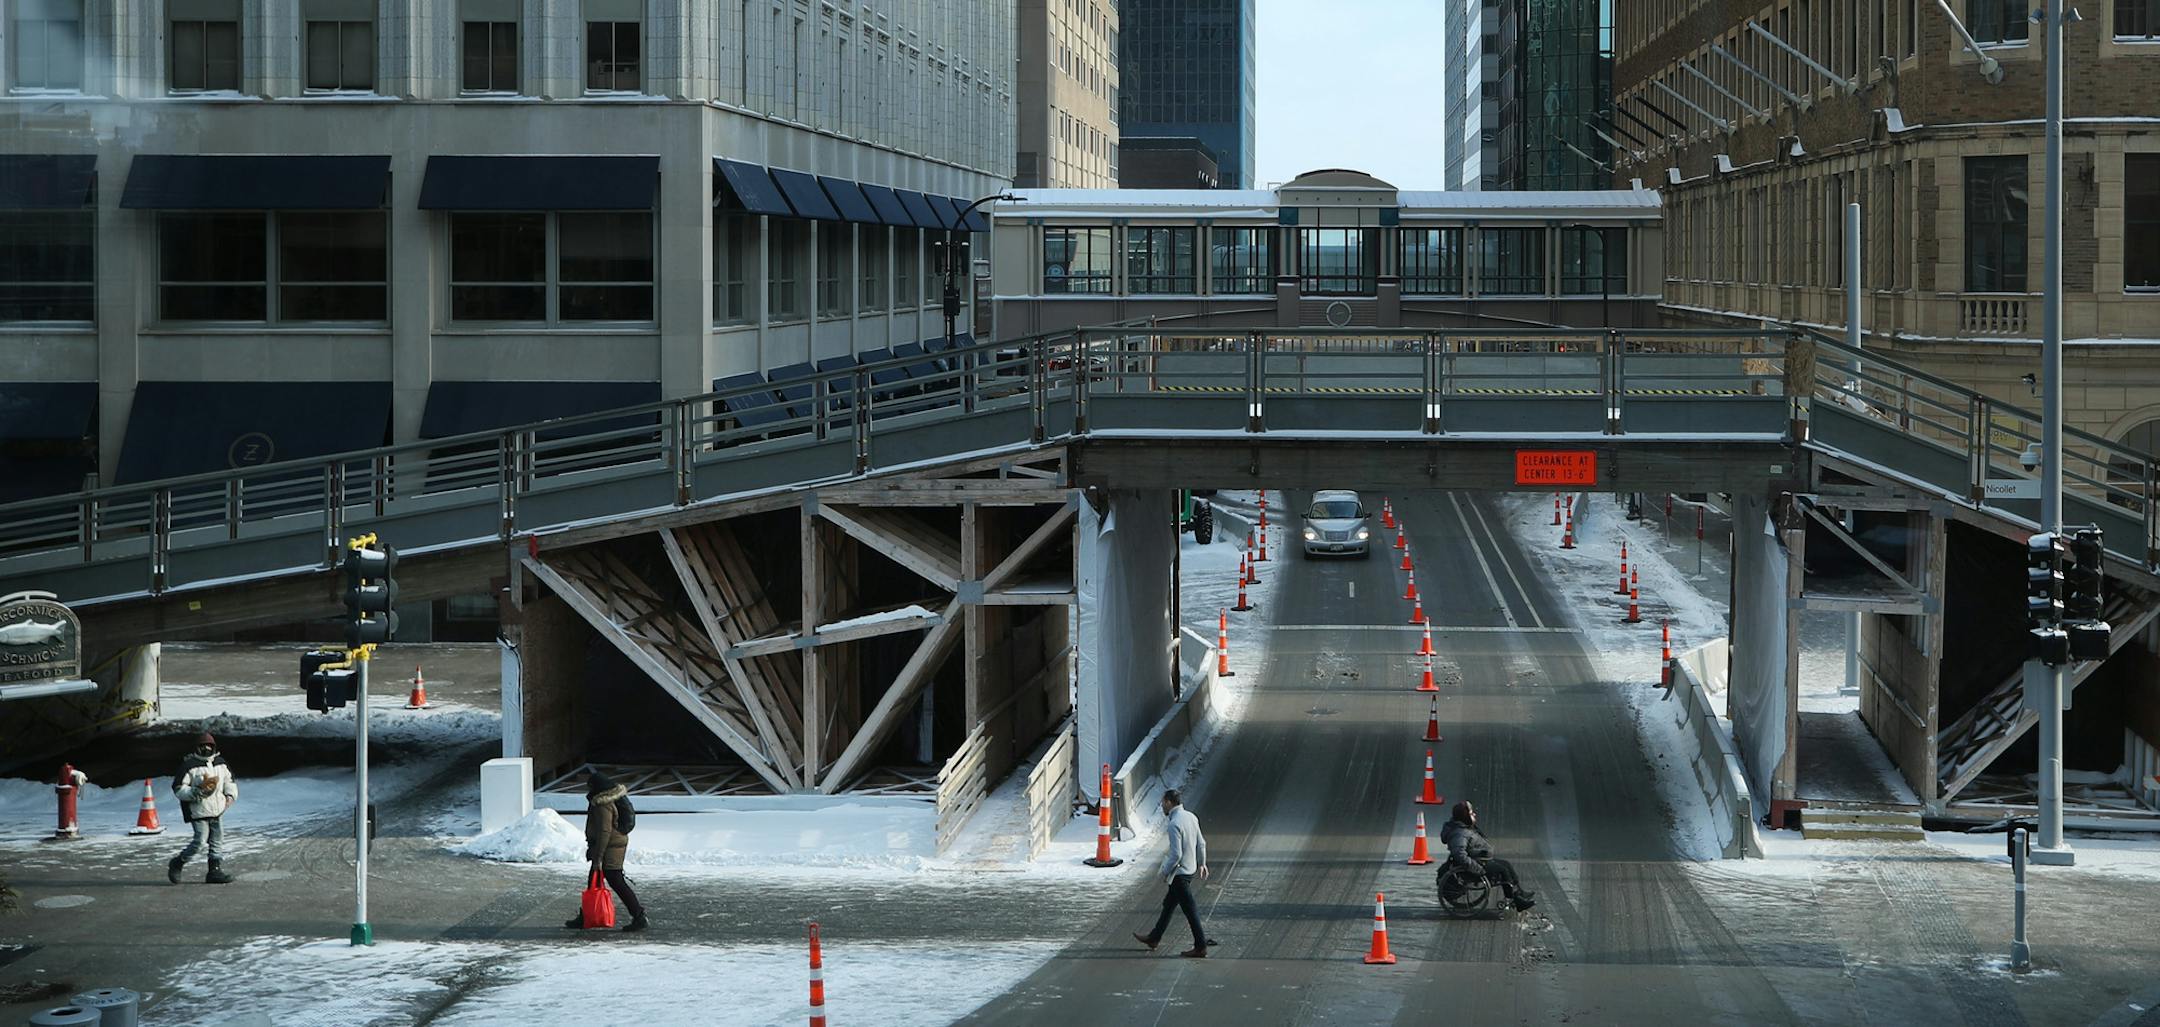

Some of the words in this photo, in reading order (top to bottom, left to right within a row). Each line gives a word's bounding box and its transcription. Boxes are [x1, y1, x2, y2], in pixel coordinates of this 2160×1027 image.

[1523, 455, 1573, 466] CLEARANCE
[1579, 455, 1589, 466] AT
[1524, 469, 1556, 480] CENTER
[1986, 484, 2017, 494] Nicollet
[2, 666, 63, 681] EAFOOD
